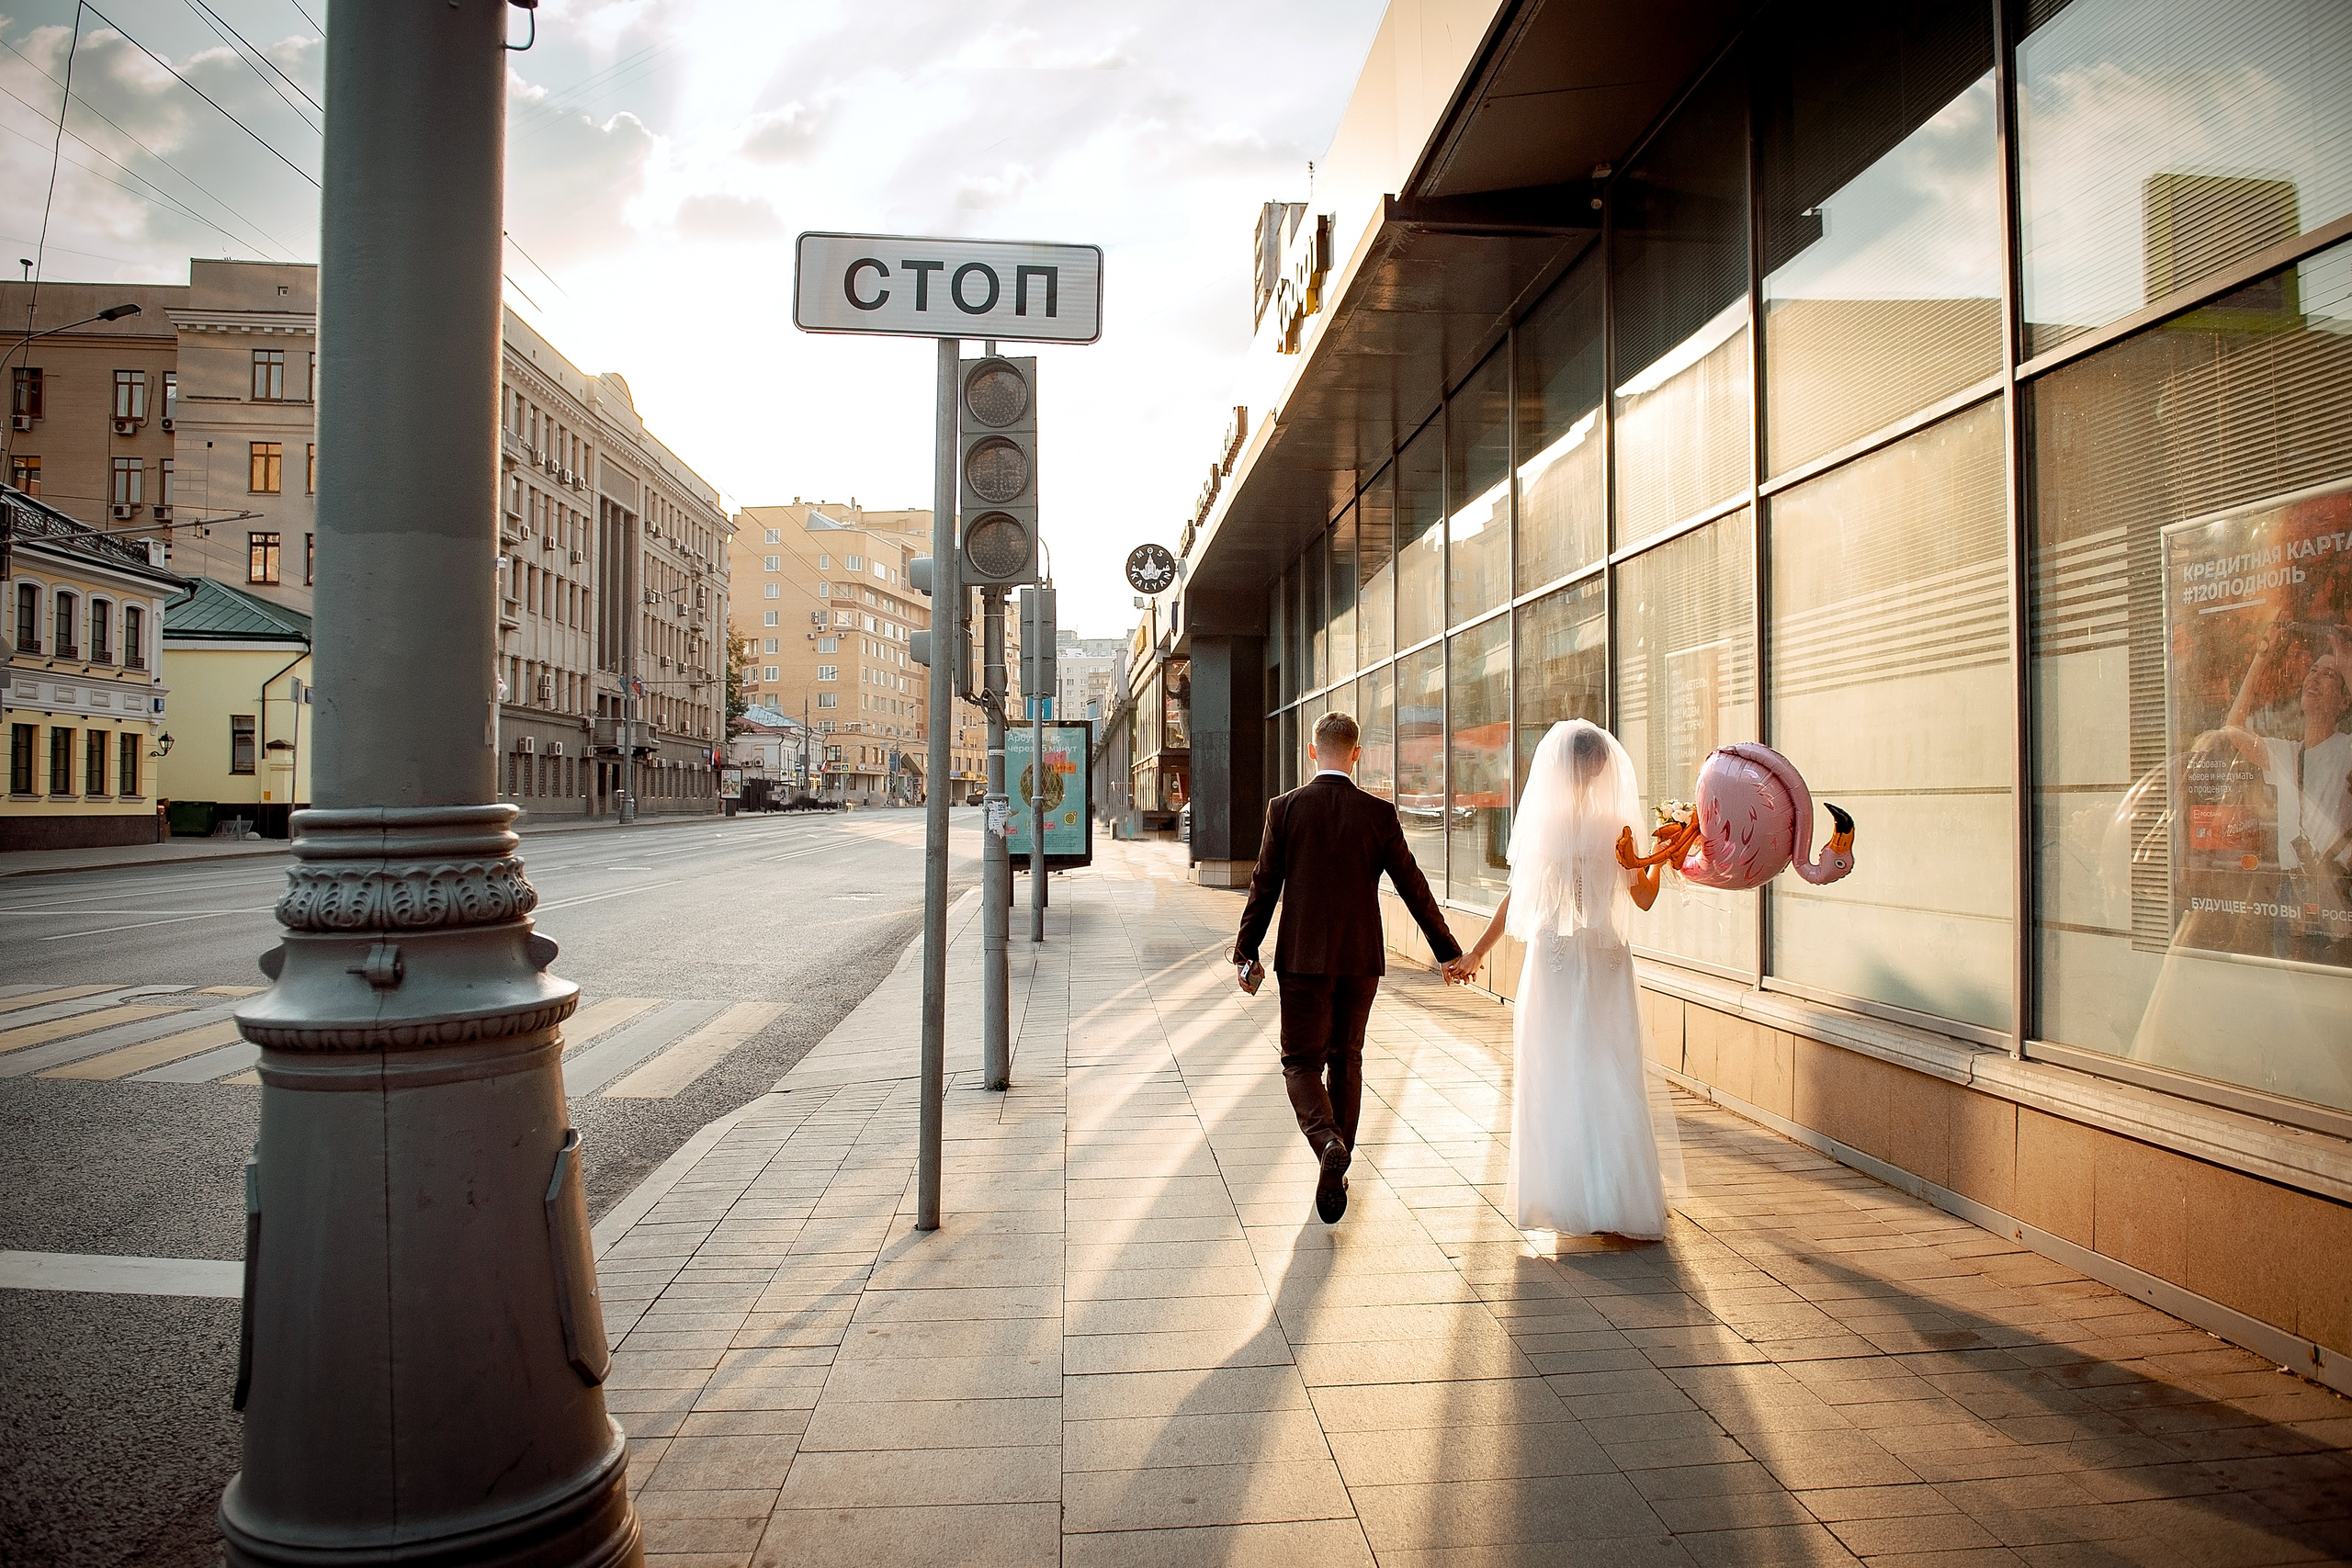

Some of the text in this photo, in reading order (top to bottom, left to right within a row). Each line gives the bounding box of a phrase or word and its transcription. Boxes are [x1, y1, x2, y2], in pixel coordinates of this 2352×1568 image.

[842, 258, 1058, 318] СТОП
[1136, 547, 1164, 558] MOS
[2183, 546, 2281, 582] КРЕДИТНАЯ
[1130, 571, 1171, 590] KALYAN
[2182, 566, 2306, 604] #120ПОДНОЛЬ
[1008, 745, 1034, 753] через
[2188, 760, 2227, 770] робовать
[2188, 772, 2254, 783] новое и не думать
[2194, 785, 2233, 796] процентах
[2280, 904, 2301, 919] ВЫ
